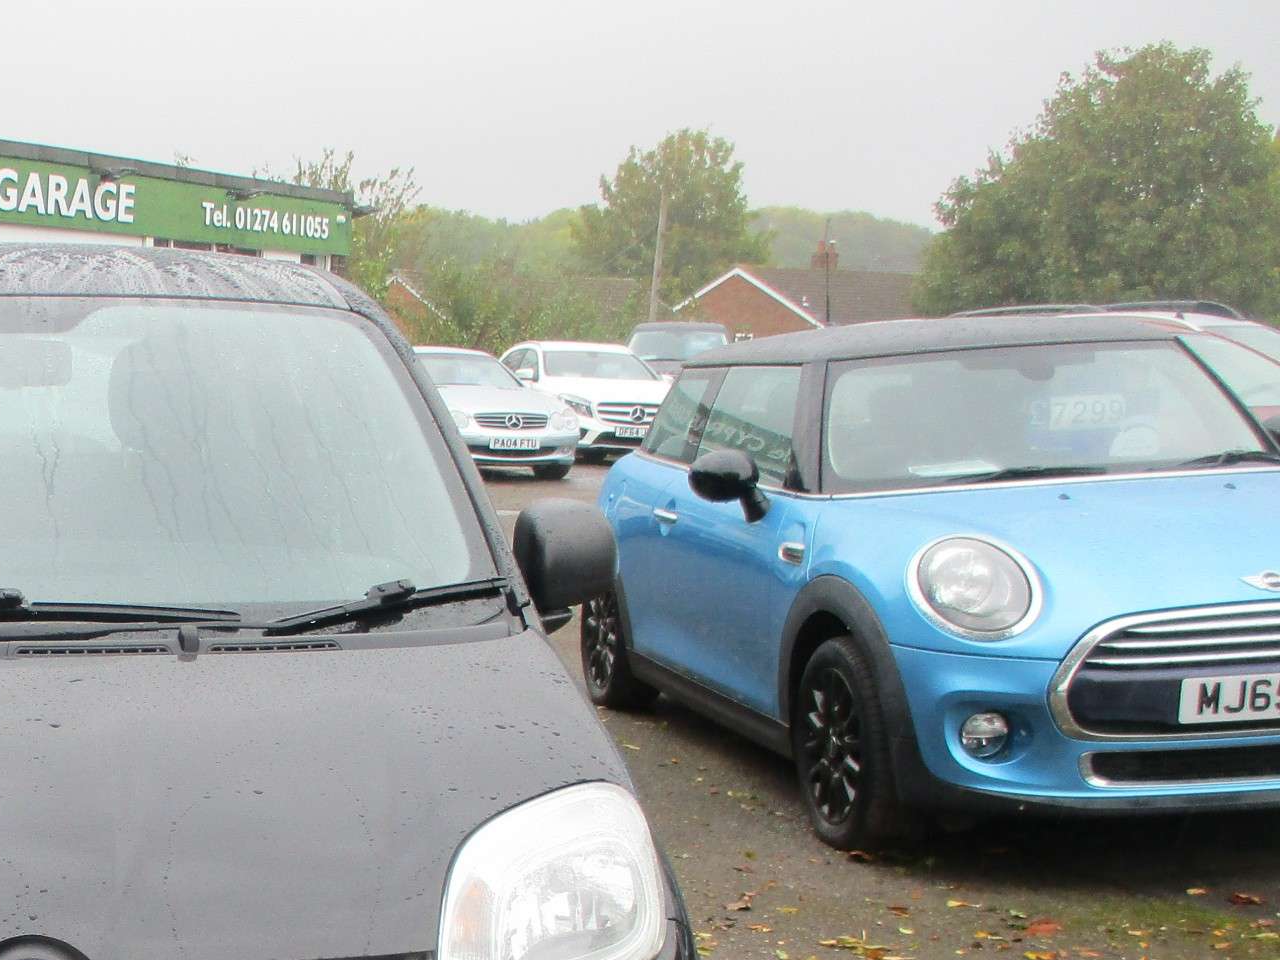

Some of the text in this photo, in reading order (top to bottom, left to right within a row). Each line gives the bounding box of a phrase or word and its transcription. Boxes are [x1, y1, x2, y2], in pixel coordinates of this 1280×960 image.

[201, 201, 330, 241] Tel. 01274 611055
[1196, 679, 1280, 716] MJ6
